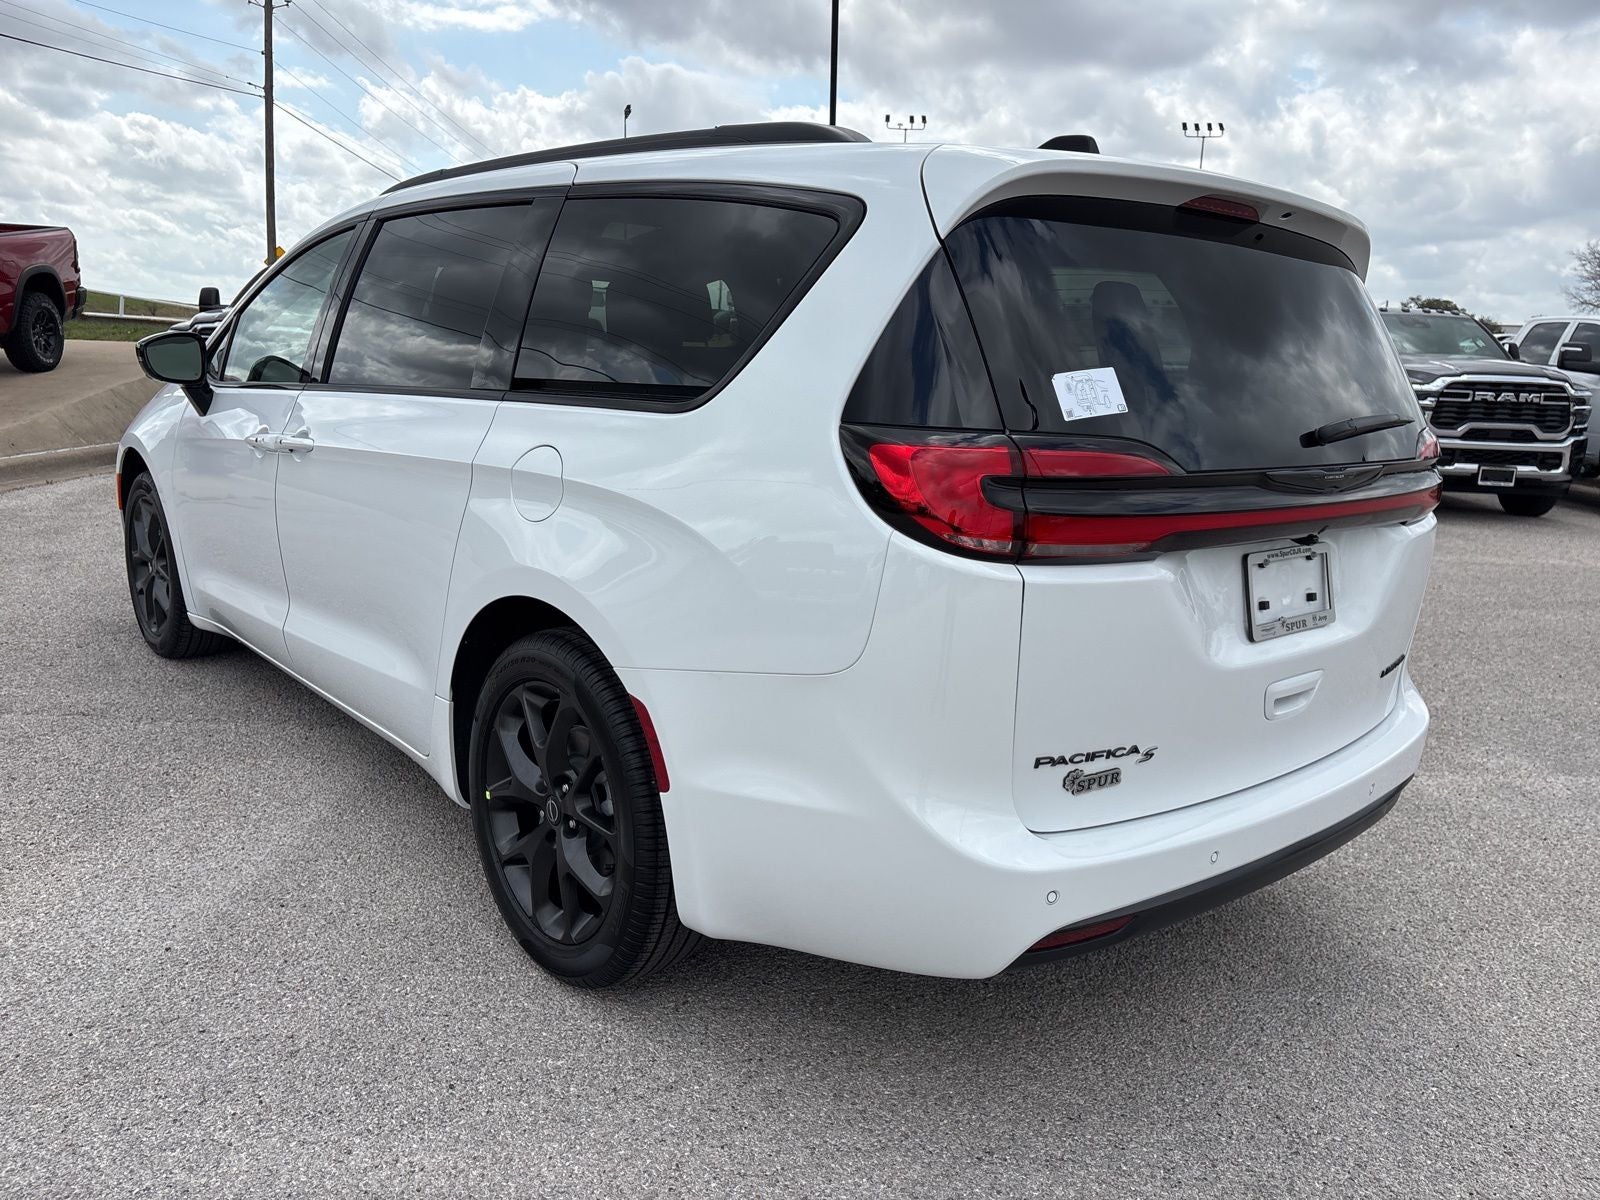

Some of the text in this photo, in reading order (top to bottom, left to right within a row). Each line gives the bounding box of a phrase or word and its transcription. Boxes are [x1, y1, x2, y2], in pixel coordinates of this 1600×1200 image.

[1474, 391, 1541, 403] RAM
[1285, 619, 1308, 631] SPUR
[1033, 744, 1158, 769] PACIFICA S
[1076, 772, 1120, 793] SPUR
